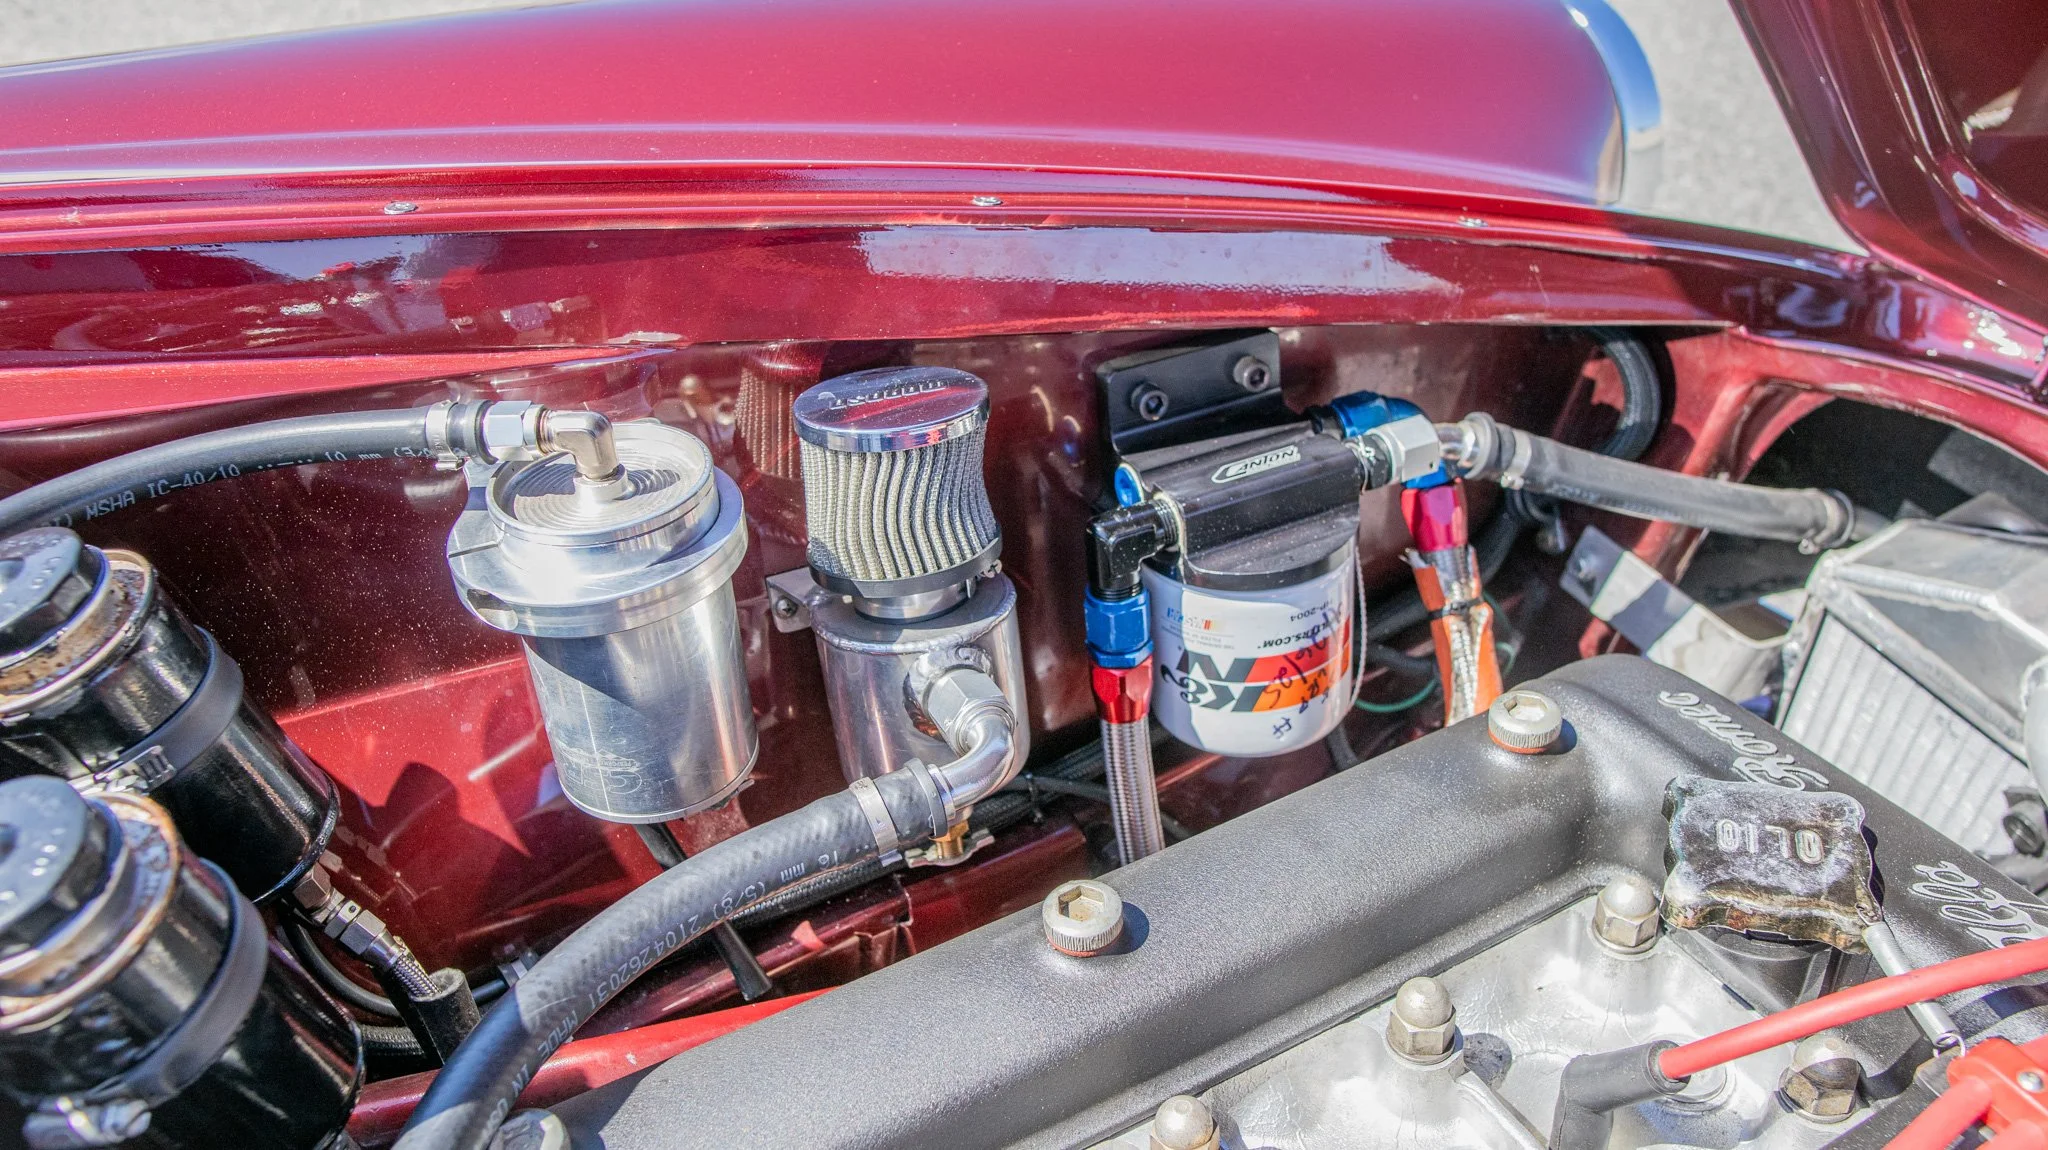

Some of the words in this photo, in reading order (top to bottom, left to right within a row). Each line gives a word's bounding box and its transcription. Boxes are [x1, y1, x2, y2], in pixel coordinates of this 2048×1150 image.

[84, 490, 136, 521] MSHA
[147, 464, 242, 499] IC-40/10
[358, 452, 382, 461] mm
[1658, 690, 1830, 791] Romeo
[818, 850, 839, 871] 16
[1716, 819, 1824, 865] OLIO
[780, 862, 805, 882] mm
[713, 881, 766, 921] (5/8)
[537, 1010, 579, 1059] MADE
[512, 1063, 531, 1099] IN
